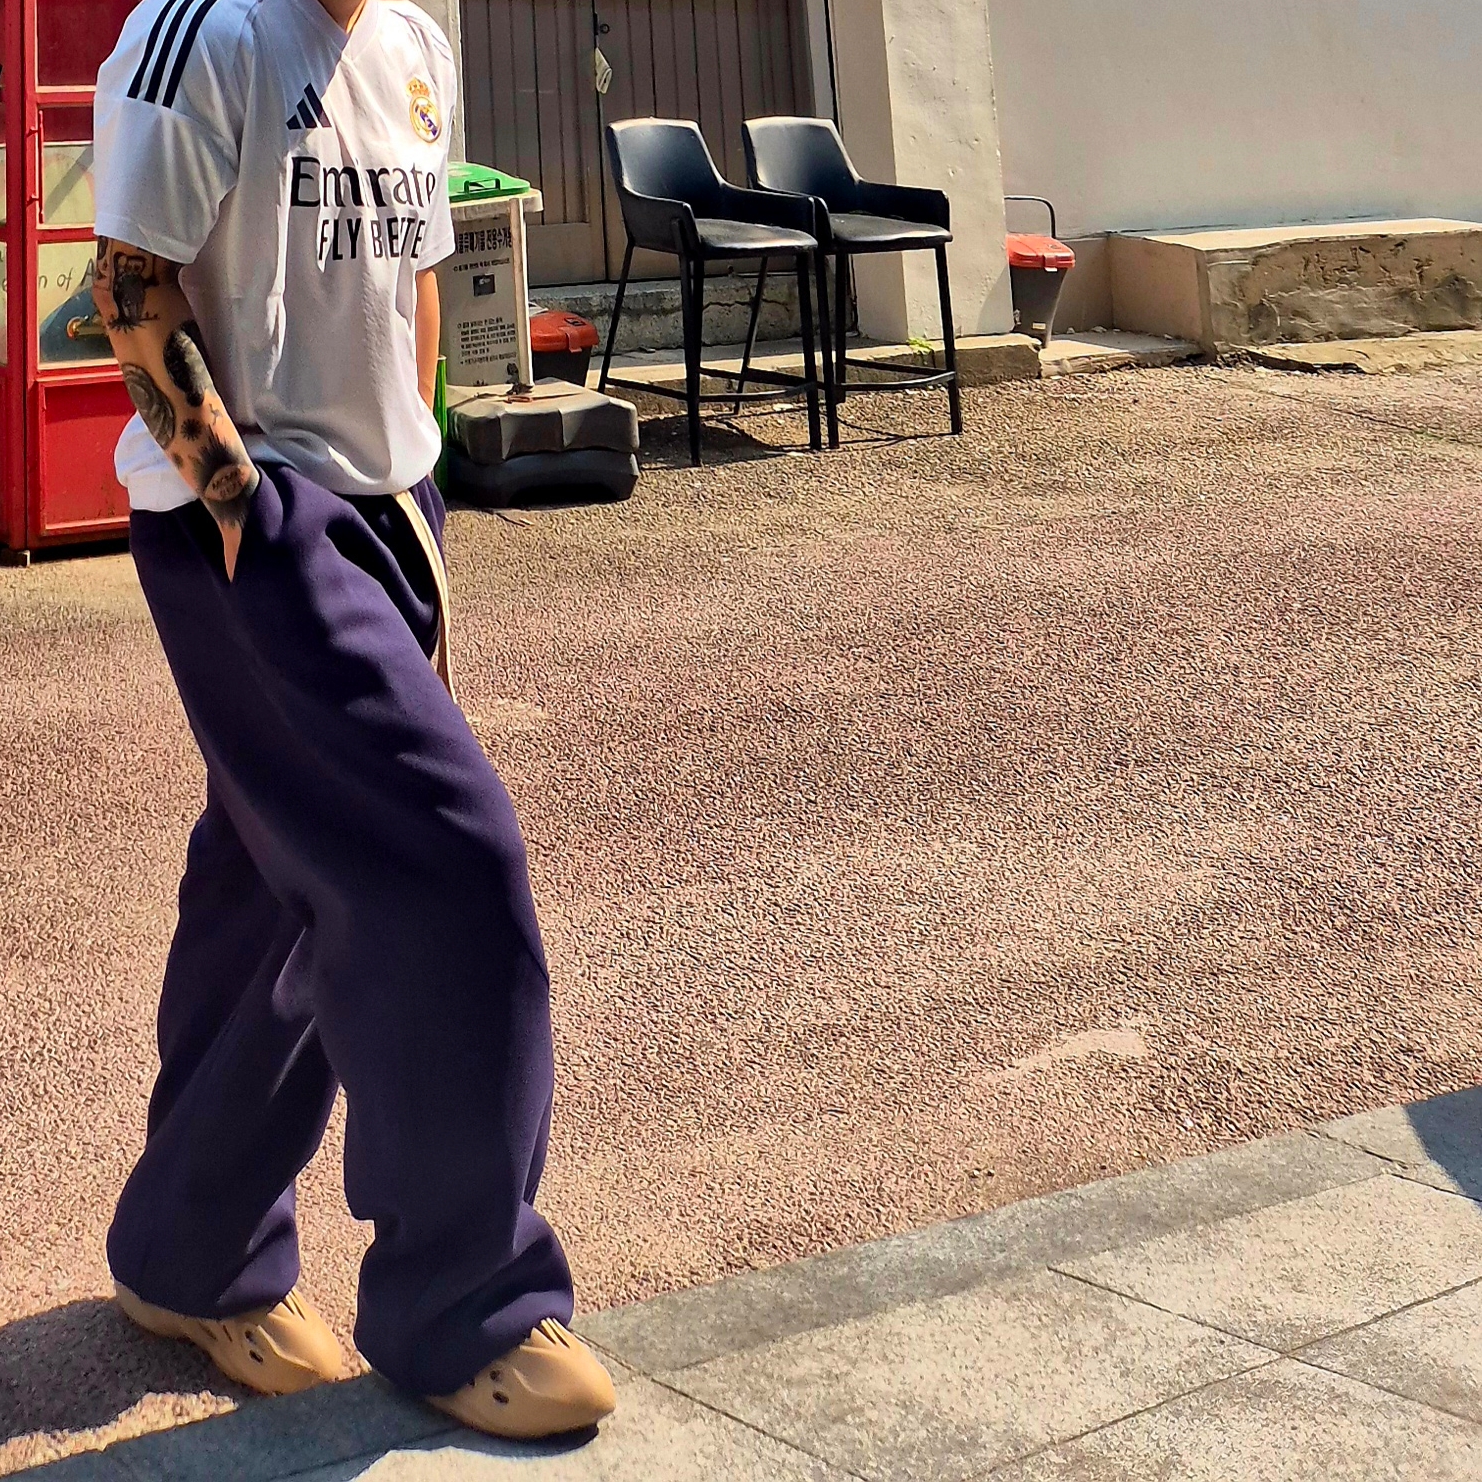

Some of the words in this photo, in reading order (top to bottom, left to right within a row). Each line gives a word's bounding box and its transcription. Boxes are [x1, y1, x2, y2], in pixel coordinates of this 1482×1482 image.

[291, 156, 436, 208] Emrate
[318, 217, 362, 261] FLY
[56, 266, 73, 291] of
